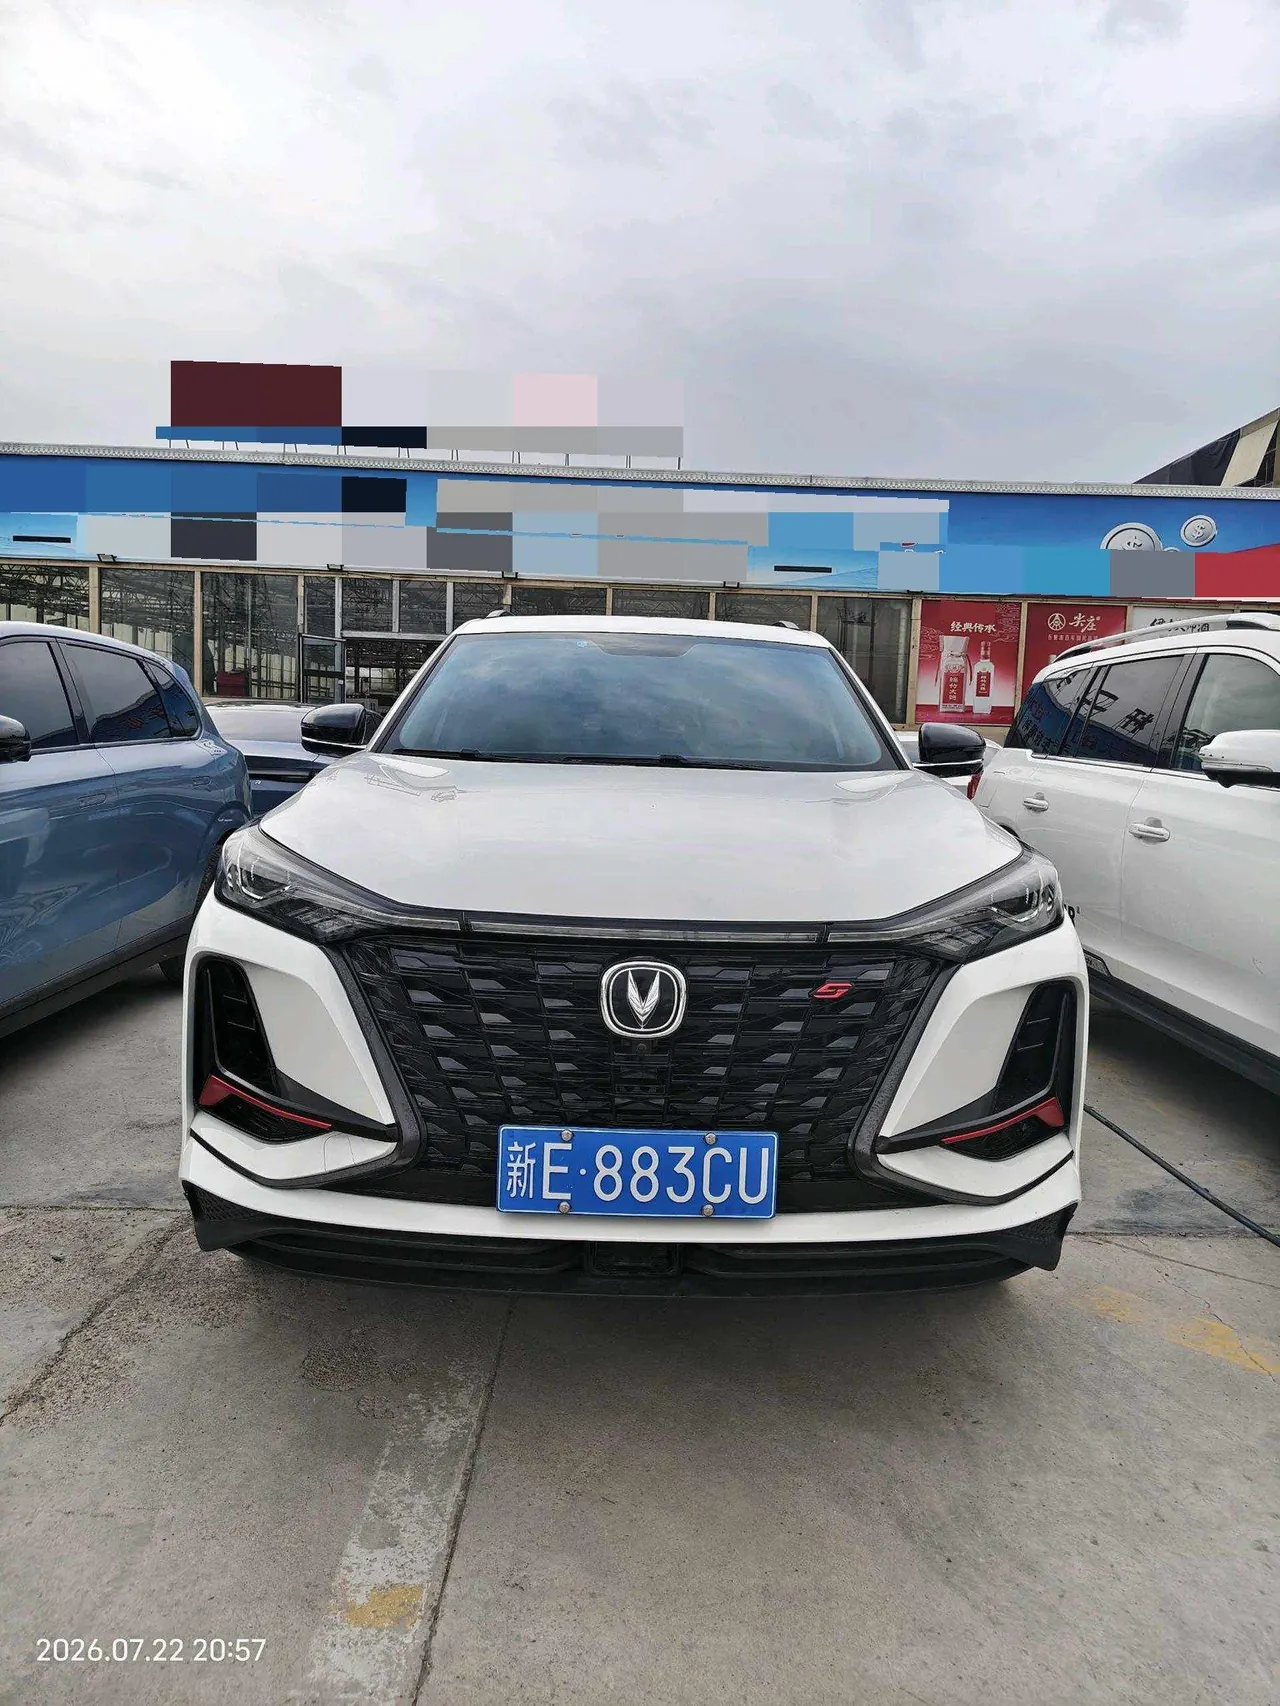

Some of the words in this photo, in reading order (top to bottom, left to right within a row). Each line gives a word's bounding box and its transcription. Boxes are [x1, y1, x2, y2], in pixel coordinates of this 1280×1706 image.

[950, 621, 997, 633] 经典传承
[1069, 612, 1097, 633] 尖庄
